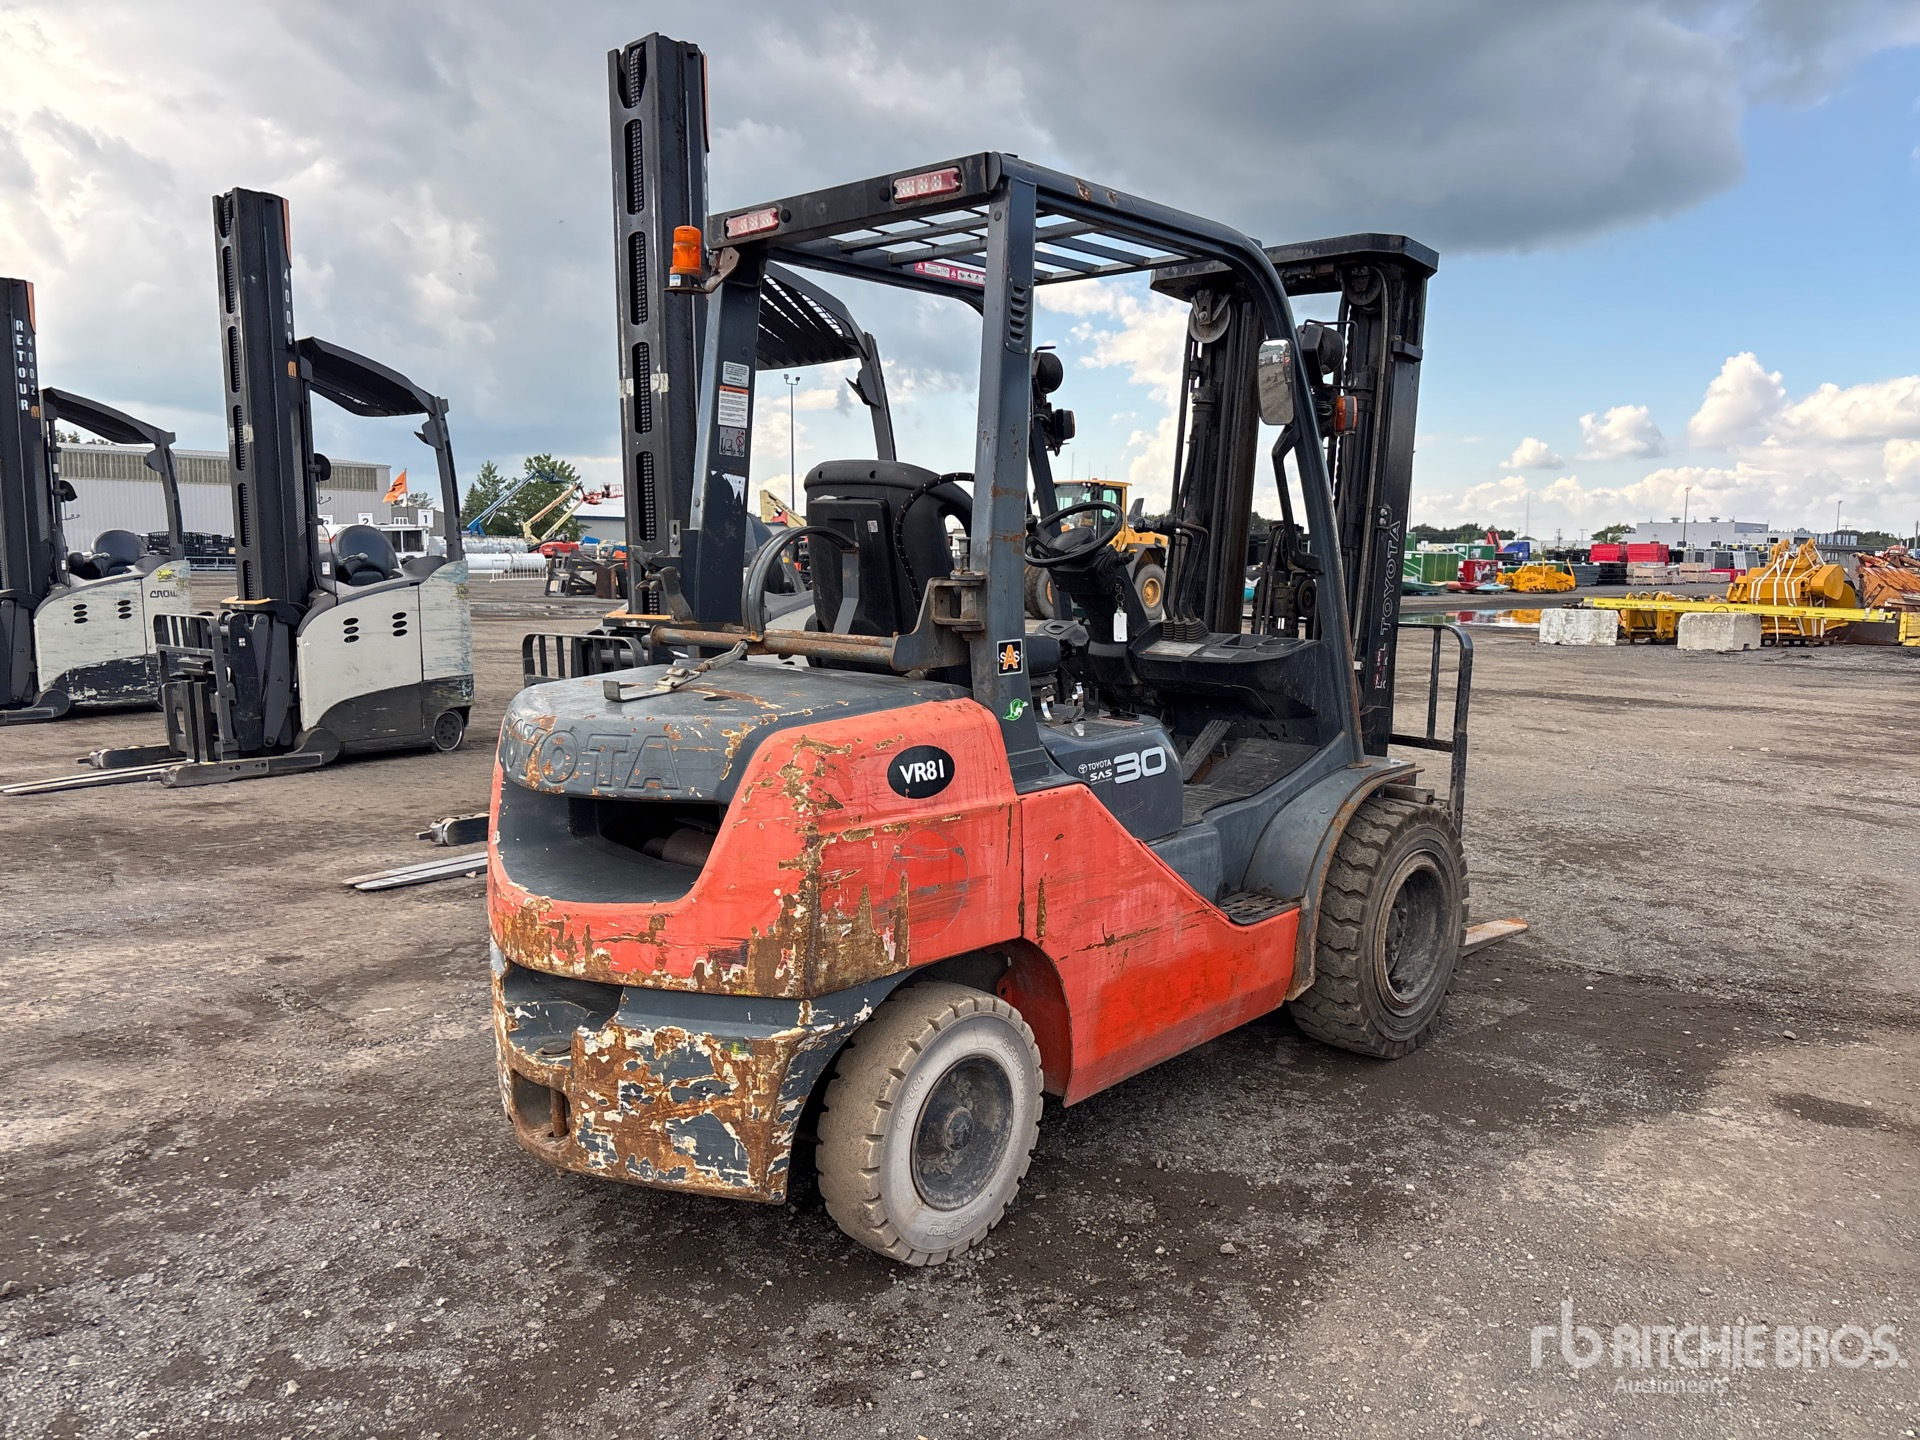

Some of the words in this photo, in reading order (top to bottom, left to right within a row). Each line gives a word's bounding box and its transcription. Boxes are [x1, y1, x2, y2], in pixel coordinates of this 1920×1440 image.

[283, 268, 293, 345] 4008
[15, 319, 29, 411] RETOUR
[27, 336, 36, 396] 4002
[150, 590, 178, 599] CROW
[1380, 521, 1400, 636] TOYOTA
[1000, 645, 1021, 670] SAS
[899, 758, 945, 785] VR81
[1087, 758, 1112, 771] TOYOTA
[1090, 769, 1113, 781] SAS
[1113, 746, 1167, 784] 30
